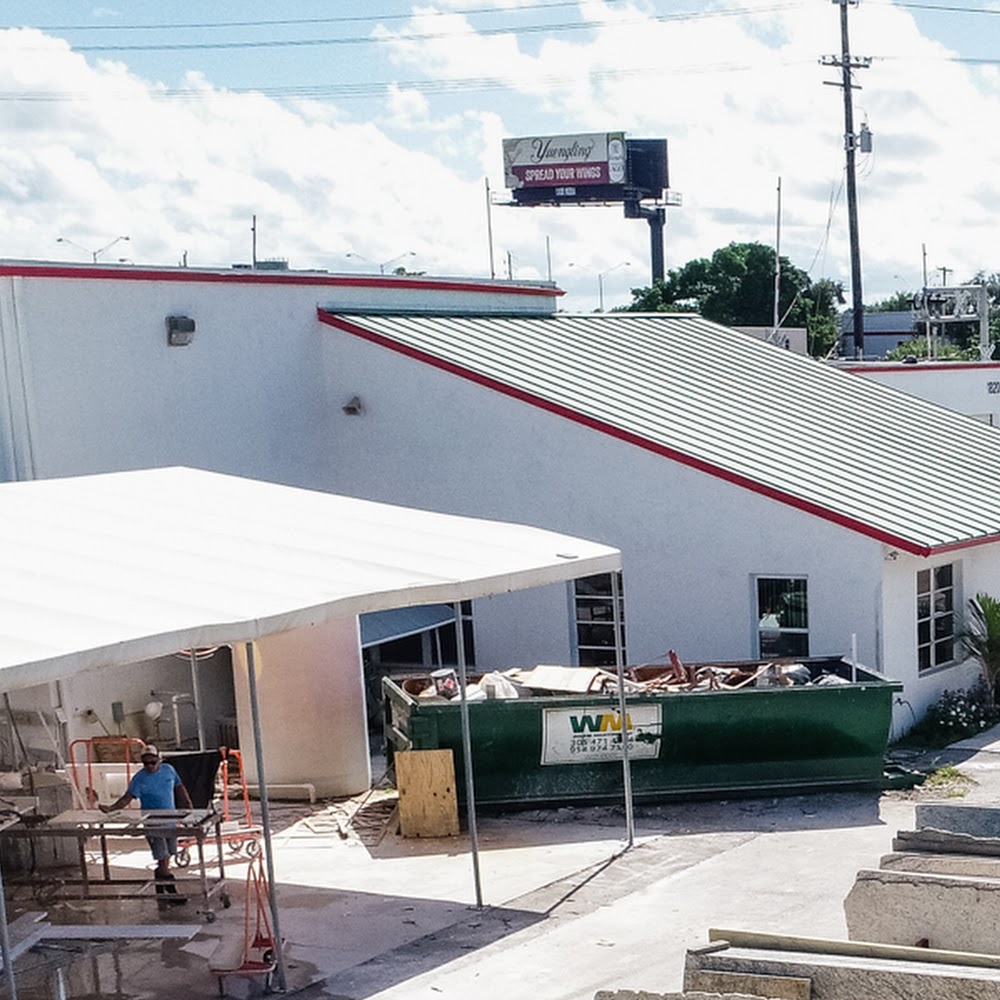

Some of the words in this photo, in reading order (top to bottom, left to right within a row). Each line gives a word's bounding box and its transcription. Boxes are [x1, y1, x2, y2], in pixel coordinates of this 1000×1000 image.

[531, 138, 595, 163] Yuengling
[525, 168, 554, 181] SPREAD
[555, 167, 575, 180] YOUR
[576, 166, 601, 179] WINGS
[570, 713, 633, 733] WM
